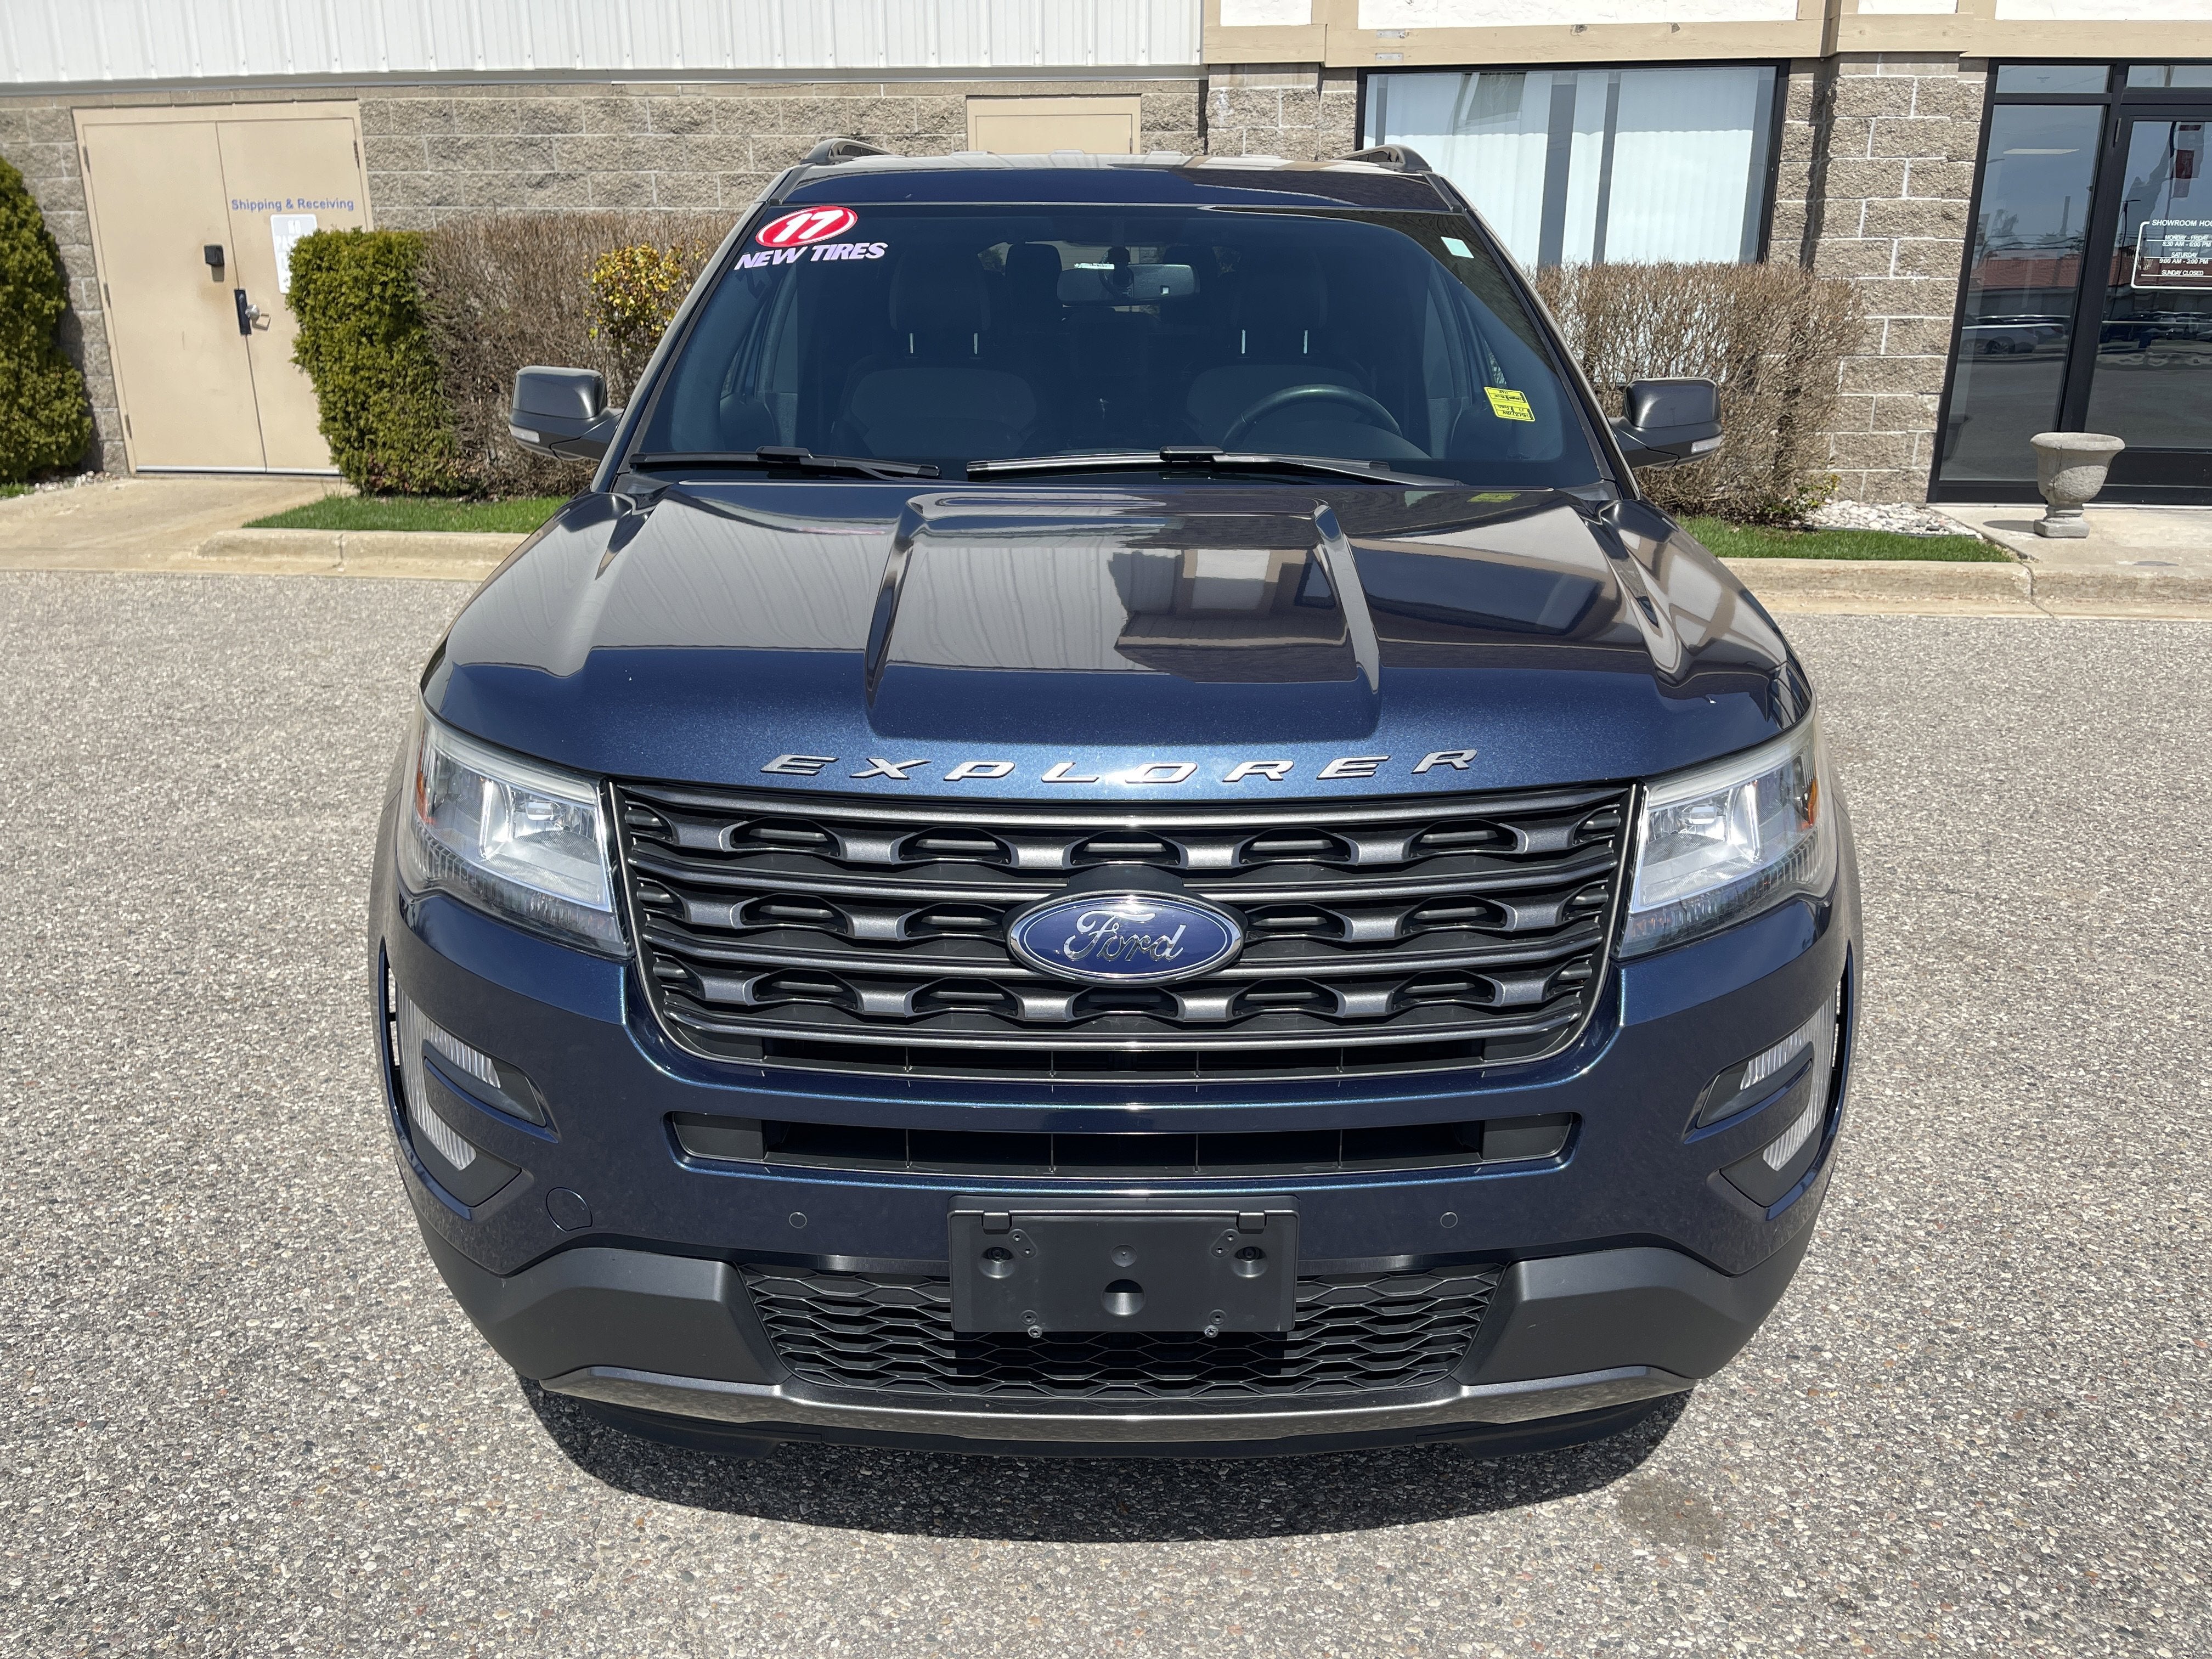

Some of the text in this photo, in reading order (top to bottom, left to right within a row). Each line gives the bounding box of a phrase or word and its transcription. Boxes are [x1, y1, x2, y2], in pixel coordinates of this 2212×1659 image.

[232, 198, 354, 212] Shipping & Receiving
[773, 210, 844, 242] 17
[733, 242, 888, 270] NEW TIRES
[760, 749, 1477, 783] EXPLORER
[1064, 910, 1187, 961] Ford
